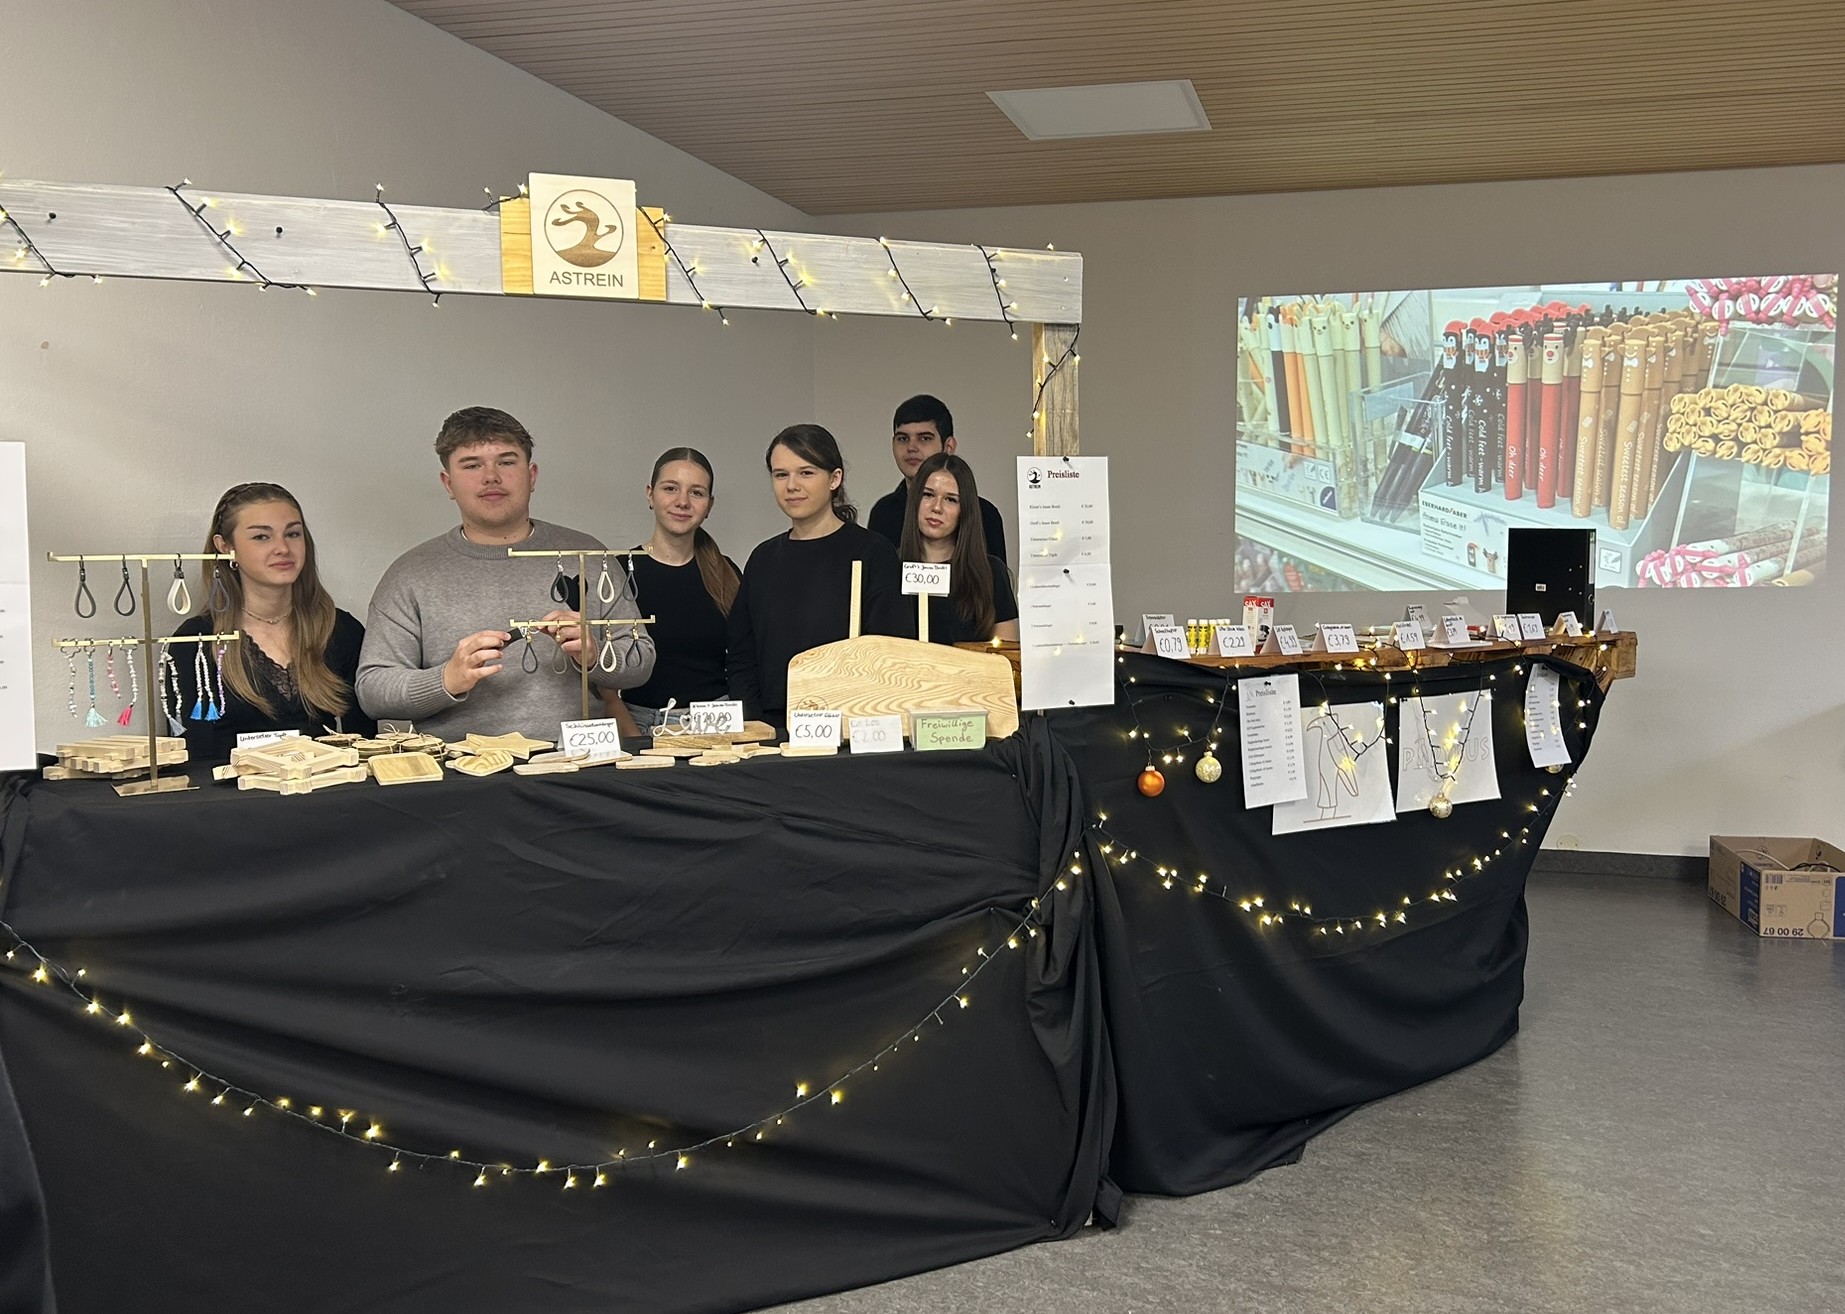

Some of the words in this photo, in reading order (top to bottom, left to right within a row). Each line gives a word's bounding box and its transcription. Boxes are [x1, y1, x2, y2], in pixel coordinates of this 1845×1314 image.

[549, 271, 623, 287] ASTREIN
[1508, 445, 1516, 458] Oh
[1539, 447, 1546, 459] Oh
[1621, 441, 1632, 482] Sweetest
[1047, 470, 1080, 479] Preisliste
[1617, 484, 1627, 513] season
[921, 719, 974, 731] Freiwillige
[930, 731, 973, 745] Spende
[1763, 927, 1775, 936] 67
[1777, 927, 1790, 936] 00
[1791, 927, 1804, 936] 29
